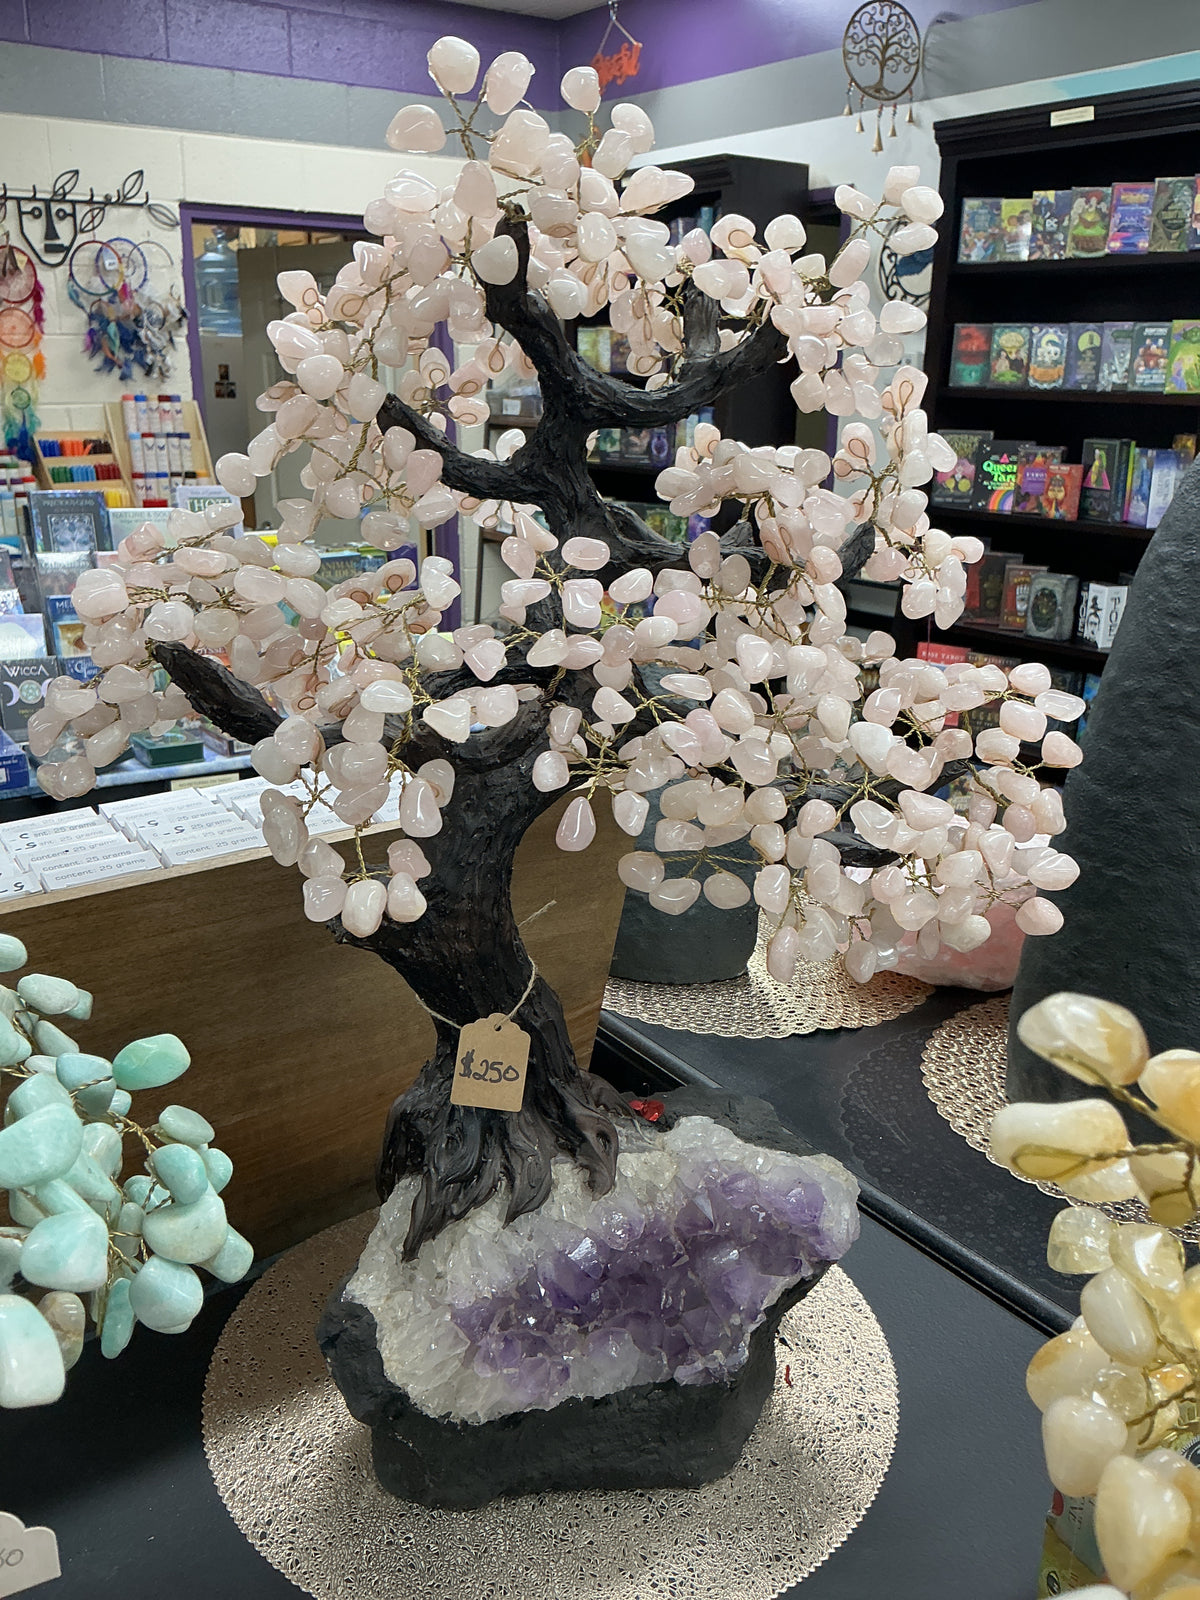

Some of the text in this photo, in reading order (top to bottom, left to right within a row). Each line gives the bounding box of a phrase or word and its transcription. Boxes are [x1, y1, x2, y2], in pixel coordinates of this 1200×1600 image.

[3, 663, 49, 678] WICCA
[215, 840, 228, 849] 25
[230, 834, 259, 847] grams
[85, 855, 100, 864] 25
[102, 849, 132, 861] grams
[54, 857, 146, 881] content: 25 grams
[459, 1049, 520, 1084] $250
